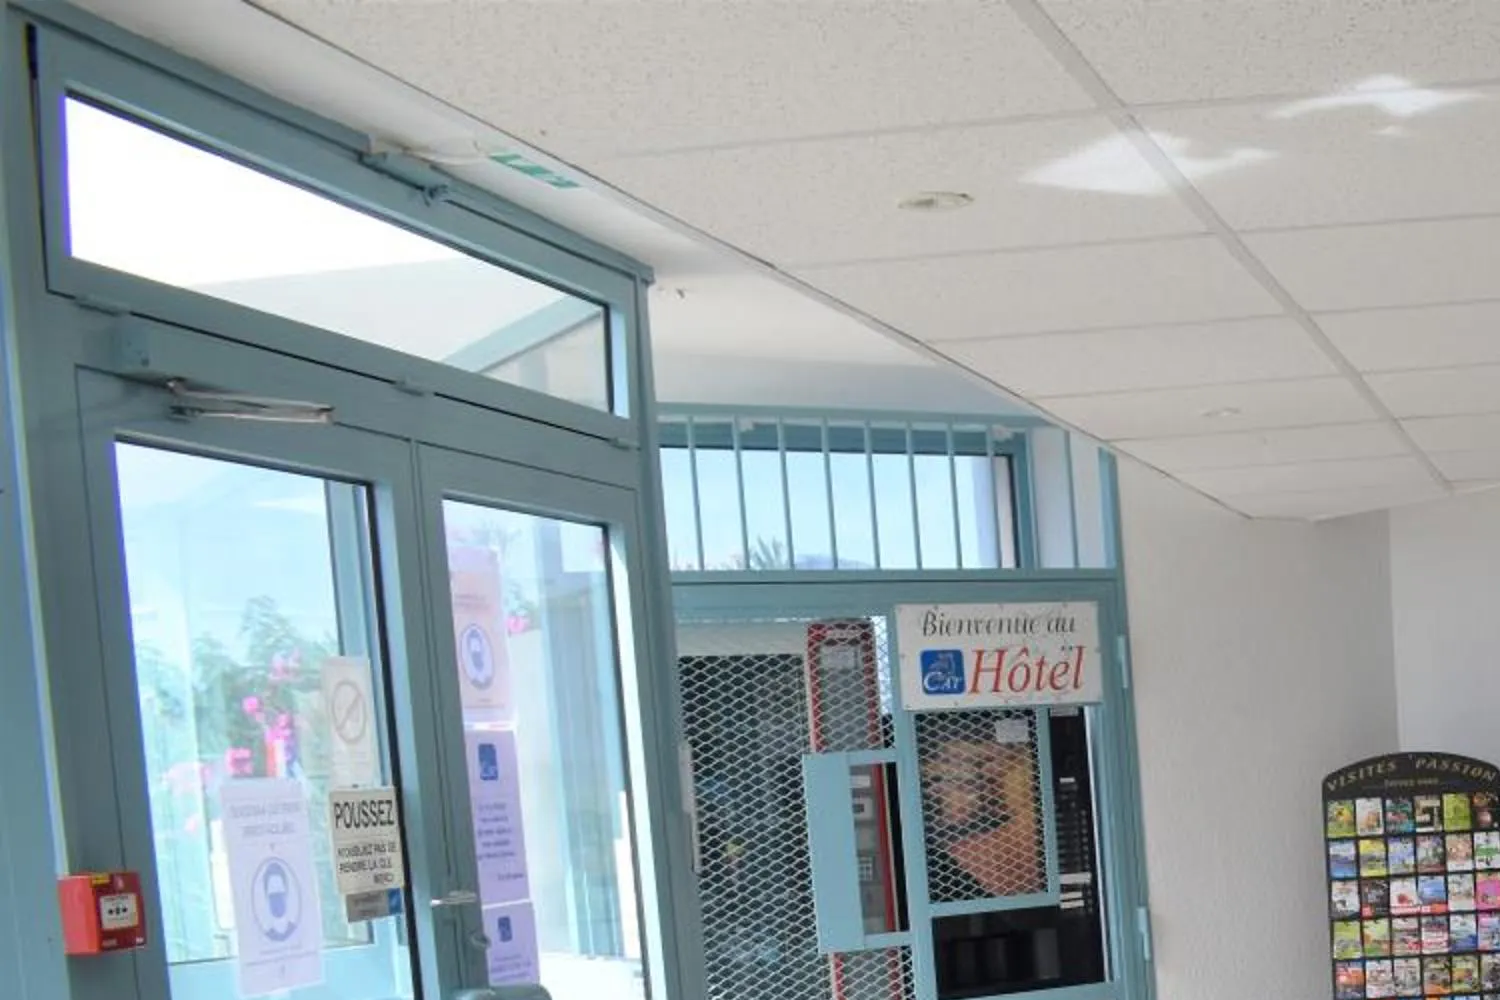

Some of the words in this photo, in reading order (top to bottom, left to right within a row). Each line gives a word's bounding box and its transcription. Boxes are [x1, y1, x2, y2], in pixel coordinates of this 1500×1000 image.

[922, 611, 1041, 637] Bienvenue
[1047, 615, 1077, 634] au
[1415, 758, 1498, 782] PASSION
[334, 799, 395, 829] POUSSEZ
